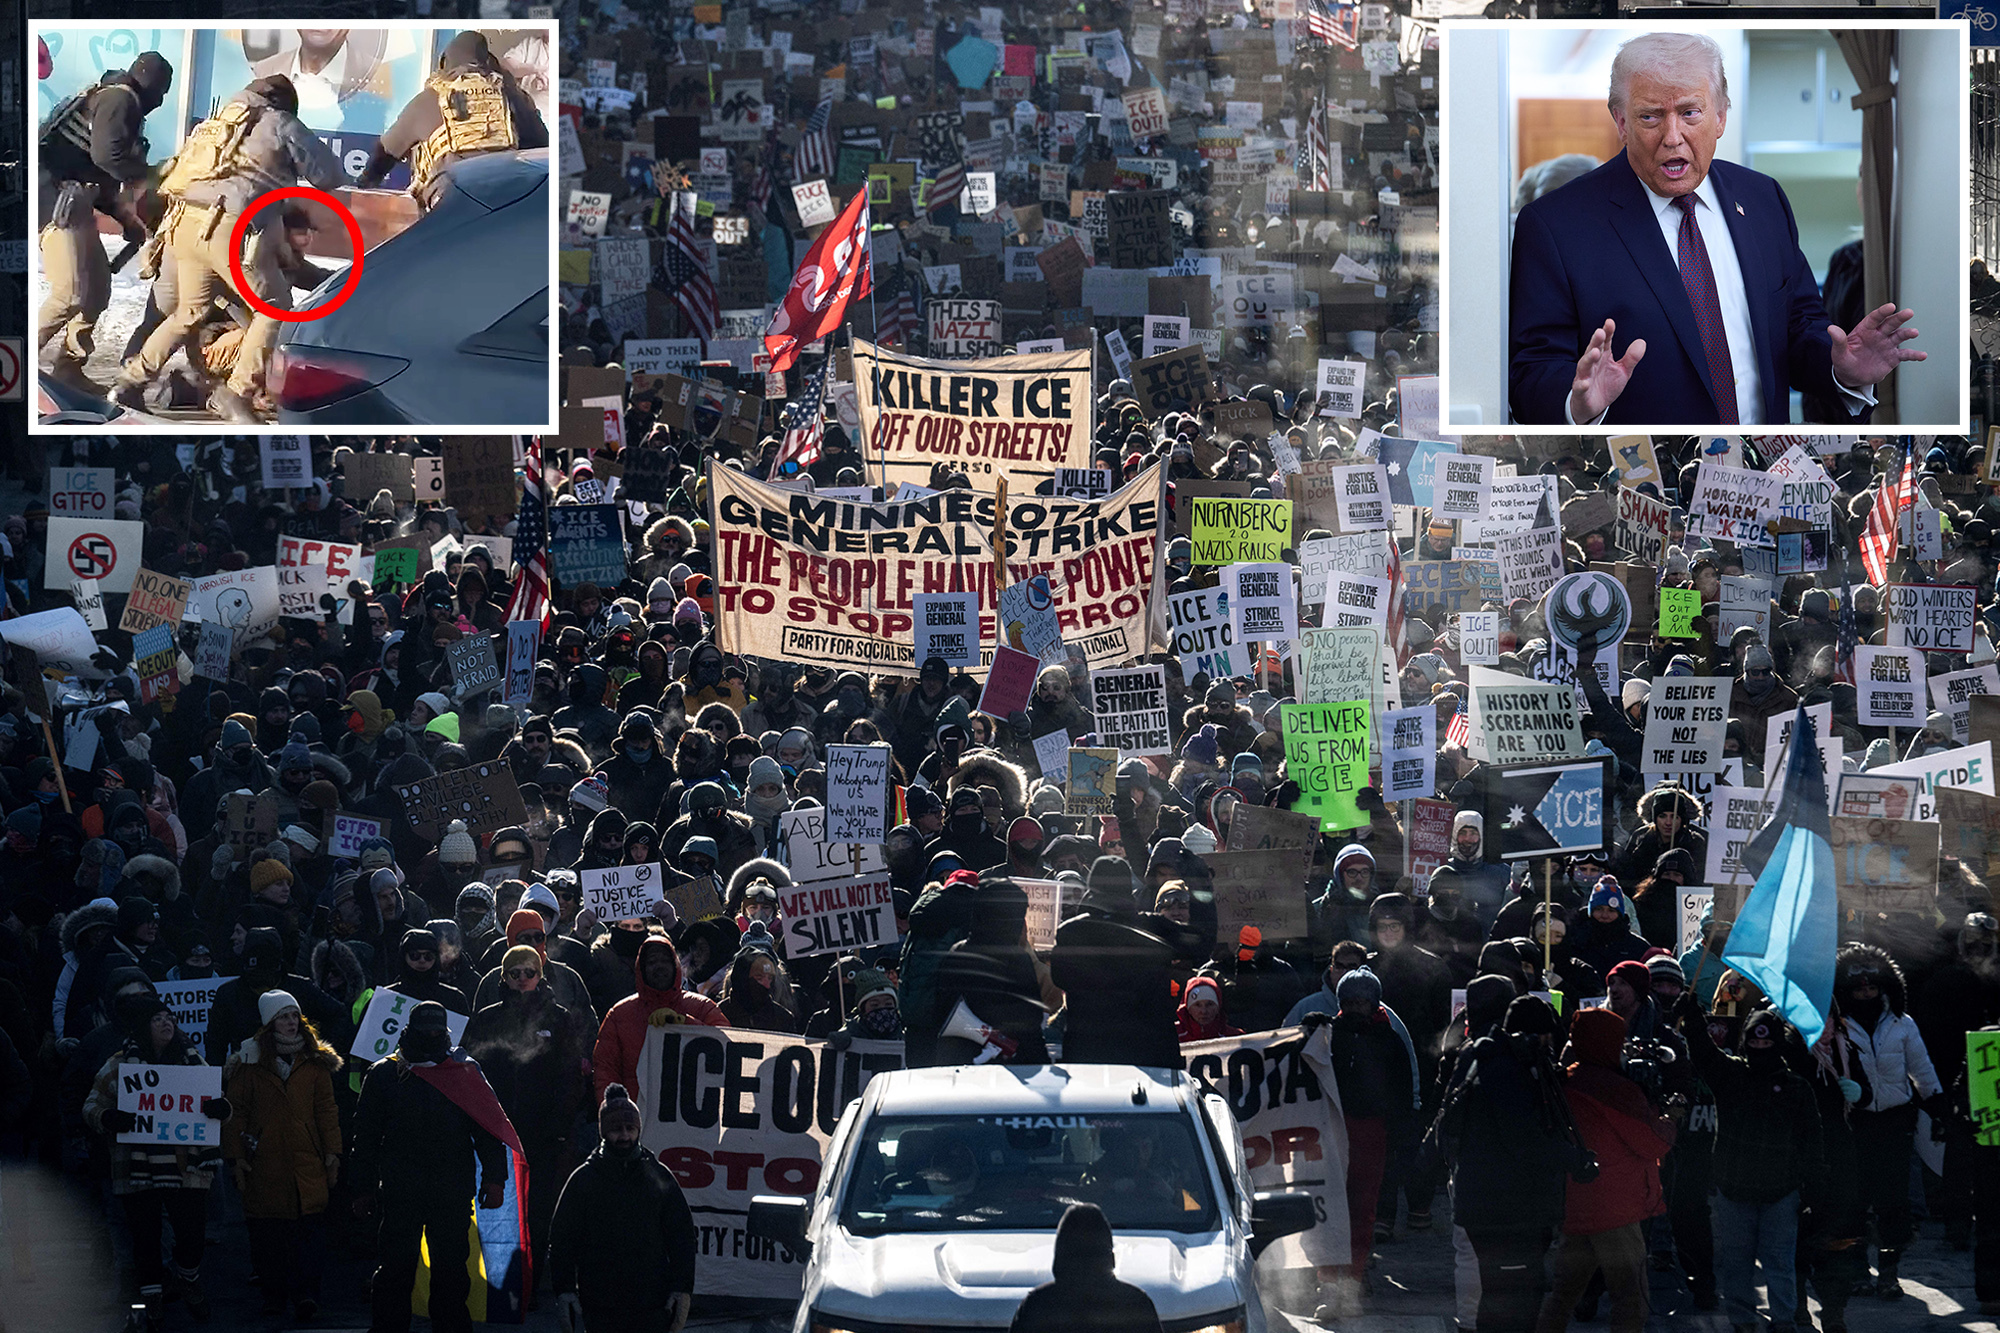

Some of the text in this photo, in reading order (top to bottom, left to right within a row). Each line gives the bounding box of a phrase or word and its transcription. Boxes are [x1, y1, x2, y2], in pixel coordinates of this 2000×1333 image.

[1128, 102, 1160, 118] ICE
[1132, 117, 1164, 133] OUT!
[581, 195, 601, 206] NO
[796, 184, 824, 200] FUCK
[578, 216, 596, 226] NO
[715, 219, 745, 230] ICE
[1114, 215, 1159, 230] THE
[1115, 248, 1168, 267] FUCK
[1237, 277, 1275, 294] ICE
[931, 302, 980, 320] THIS
[934, 321, 991, 339] NAZI
[1152, 330, 1181, 340] GENERAL
[667, 345, 698, 355] THEN
[1140, 353, 1206, 393] ICE
[1327, 366, 1356, 376] EXPAND THE
[1326, 375, 1355, 386] GENERAL
[871, 367, 1071, 419] KILLER ICE
[1151, 378, 1213, 410] OUT
[1219, 409, 1258, 421] FUCK
[871, 413, 1072, 462] OFF OUR STREETS!
[1448, 461, 1482, 472] EXPAND THE
[66, 472, 98, 491] ICE
[1062, 469, 1105, 488] KILLER
[1346, 472, 1376, 484] JUSTICE
[1447, 471, 1482, 485] GENERAL
[1703, 469, 1774, 489] I DRINK MY
[1346, 482, 1379, 495] FOR ALEX
[1447, 489, 1478, 502] STRIKE!
[1702, 487, 1770, 508] HORCHATA
[53, 491, 106, 510] GTFO
[567, 510, 600, 525] ICE
[789, 494, 1103, 534] MINNESOTA
[1620, 489, 1670, 536] SHAME
[1707, 501, 1757, 521] WARM
[554, 523, 608, 538] AGENTS
[720, 495, 1157, 558] GENERAL STRIKE
[1229, 529, 1249, 539] 2.0
[560, 539, 597, 550] ARE
[1525, 531, 1556, 548] IS WHAT
[282, 539, 353, 578] ICE
[377, 551, 406, 564] FUCK
[1194, 540, 1234, 561] NAZIS
[1503, 550, 1544, 568] IT SOUNDS
[720, 530, 916, 610] THE PEOPLE
[1240, 572, 1279, 584] EXPAND THE
[1404, 562, 1462, 588] ICE
[1511, 564, 1552, 580] LIKE WHEN
[136, 574, 189, 602] NO ONE
[198, 573, 256, 593] ABOLISH ICE
[1240, 583, 1280, 597] GENERAL
[1339, 580, 1379, 596] EXPAND THE
[720, 585, 777, 614] TO
[1338, 591, 1376, 610] GENERAL
[1665, 591, 1692, 601] ICE
[1888, 588, 1973, 609] COLD WINTERS
[130, 590, 178, 621] ILLEGAL
[926, 602, 966, 612] EXPAND THE
[1172, 595, 1211, 626] ICE
[1245, 607, 1280, 621] STRIKE!
[1668, 604, 1690, 612] OUT
[926, 612, 966, 626] GENERAL
[1465, 616, 1491, 632] ICE
[1672, 614, 1689, 622] OF
[1888, 609, 1972, 628] WARM HEARTS
[451, 636, 489, 658] WE ARE
[789, 631, 855, 656] PARTY FOR
[930, 634, 964, 647] STRIKE!
[1178, 626, 1217, 654] OUT
[1314, 632, 1336, 650] NO
[1904, 628, 1962, 648] NO ICE
[138, 650, 175, 678] ICE OUT
[456, 651, 487, 673] NOT
[1197, 651, 1232, 678] MN
[1872, 655, 1909, 669] JUSTICE
[457, 665, 498, 690] AFRAID
[1094, 672, 1163, 693] GENERAL
[1870, 668, 1911, 682] FOR ALEX
[1948, 676, 1984, 692] JUSTICE
[1486, 691, 1572, 711] HISTORY IS
[1666, 685, 1715, 700] BELIEVE
[1948, 692, 1966, 704] FOR
[1096, 690, 1164, 714] STRIKE:
[1870, 701, 1900, 710] KILLED BY
[1100, 712, 1166, 732] THE PATH TO
[1288, 707, 1367, 734] DELIVER
[1486, 712, 1574, 732] SCREAMING
[1653, 706, 1723, 721] YOUR EYES
[1393, 716, 1422, 734] JUSTICE
[1672, 726, 1696, 741] NOT
[1101, 732, 1168, 750] JUSTICE
[1392, 730, 1424, 750] FOR ALEX
[1497, 734, 1566, 752] ARE YOU
[1289, 738, 1366, 764] US FROM
[1653, 750, 1707, 764] THE LIES
[829, 751, 886, 771] Hey Trump
[442, 760, 510, 787] LET YOUR
[1299, 764, 1353, 792] ICE
[452, 795, 494, 813] YOUR
[1416, 804, 1452, 820] SALT THE
[1554, 788, 1602, 830] ICE
[336, 818, 378, 836] GTFO
[857, 828, 882, 837] FREE
[602, 872, 619, 887] NO
[588, 885, 647, 904] JUSTICE
[780, 881, 891, 918] WE WILL NOT BE
[612, 900, 654, 918] PEACE
[792, 908, 881, 953] SILENT
[123, 1070, 159, 1093] NO
[659, 1033, 764, 1129] ICE
[157, 1123, 206, 1141] ICE
